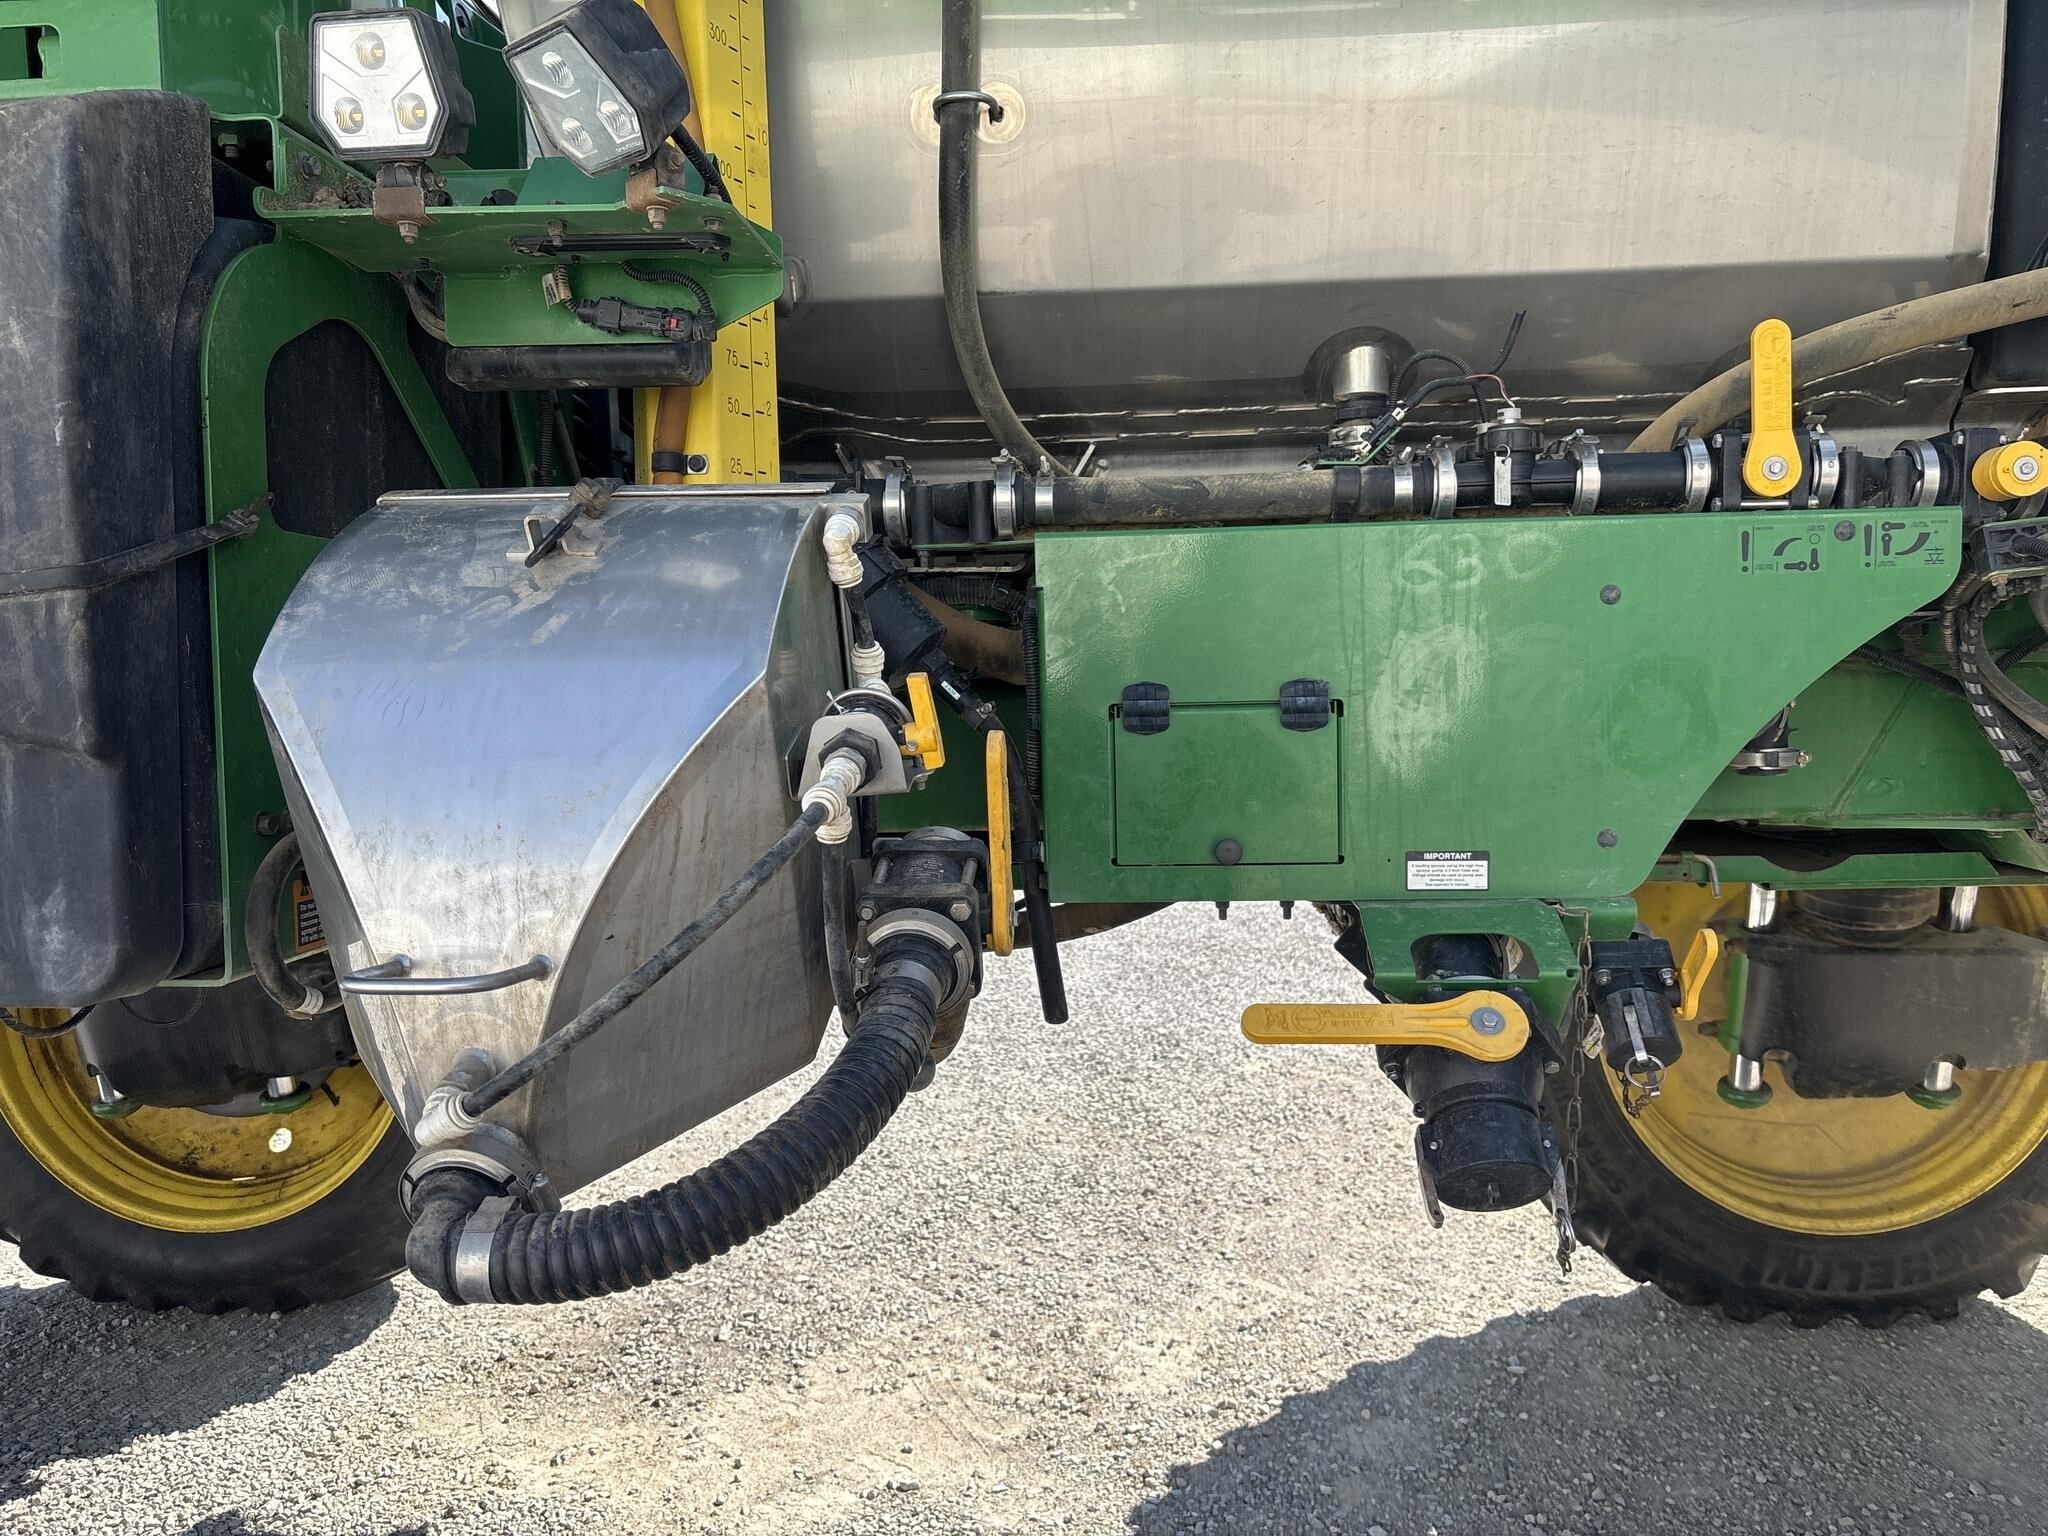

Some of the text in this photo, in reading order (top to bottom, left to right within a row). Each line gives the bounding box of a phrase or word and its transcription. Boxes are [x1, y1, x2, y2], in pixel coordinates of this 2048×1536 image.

[708, 21, 727, 46] 300
[757, 127, 768, 146] 10
[719, 159, 732, 179] 00
[763, 309, 769, 326] 4
[726, 348, 739, 367] 75
[763, 351, 770, 368] 3
[728, 396, 740, 415] 50
[766, 400, 772, 417] 2
[730, 457, 743, 475] 25
[1423, 852, 1472, 860] IMPORTANT
